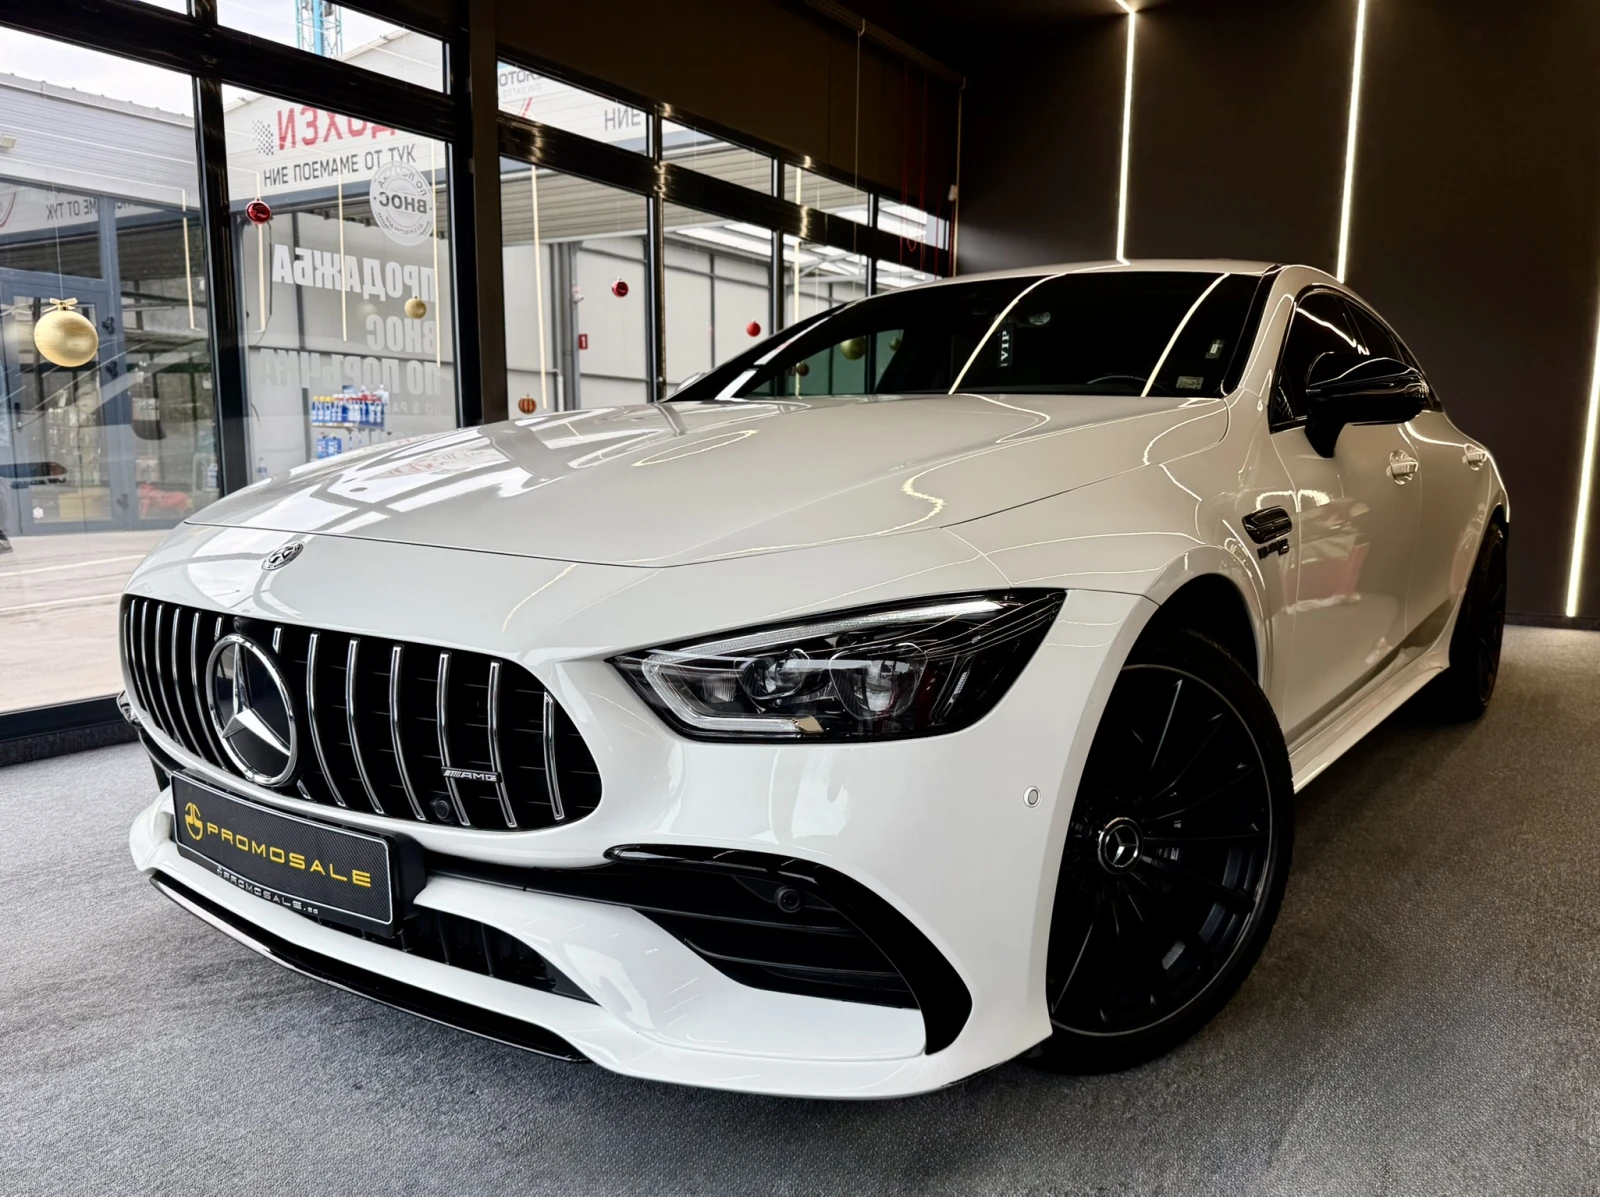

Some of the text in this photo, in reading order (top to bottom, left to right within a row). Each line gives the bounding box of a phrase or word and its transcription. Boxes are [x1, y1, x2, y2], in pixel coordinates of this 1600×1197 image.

[264, 144, 416, 187] НИЕ ПОЕМАМЕ ОТ ТУК
[207, 822, 371, 888] PROMOSALE
